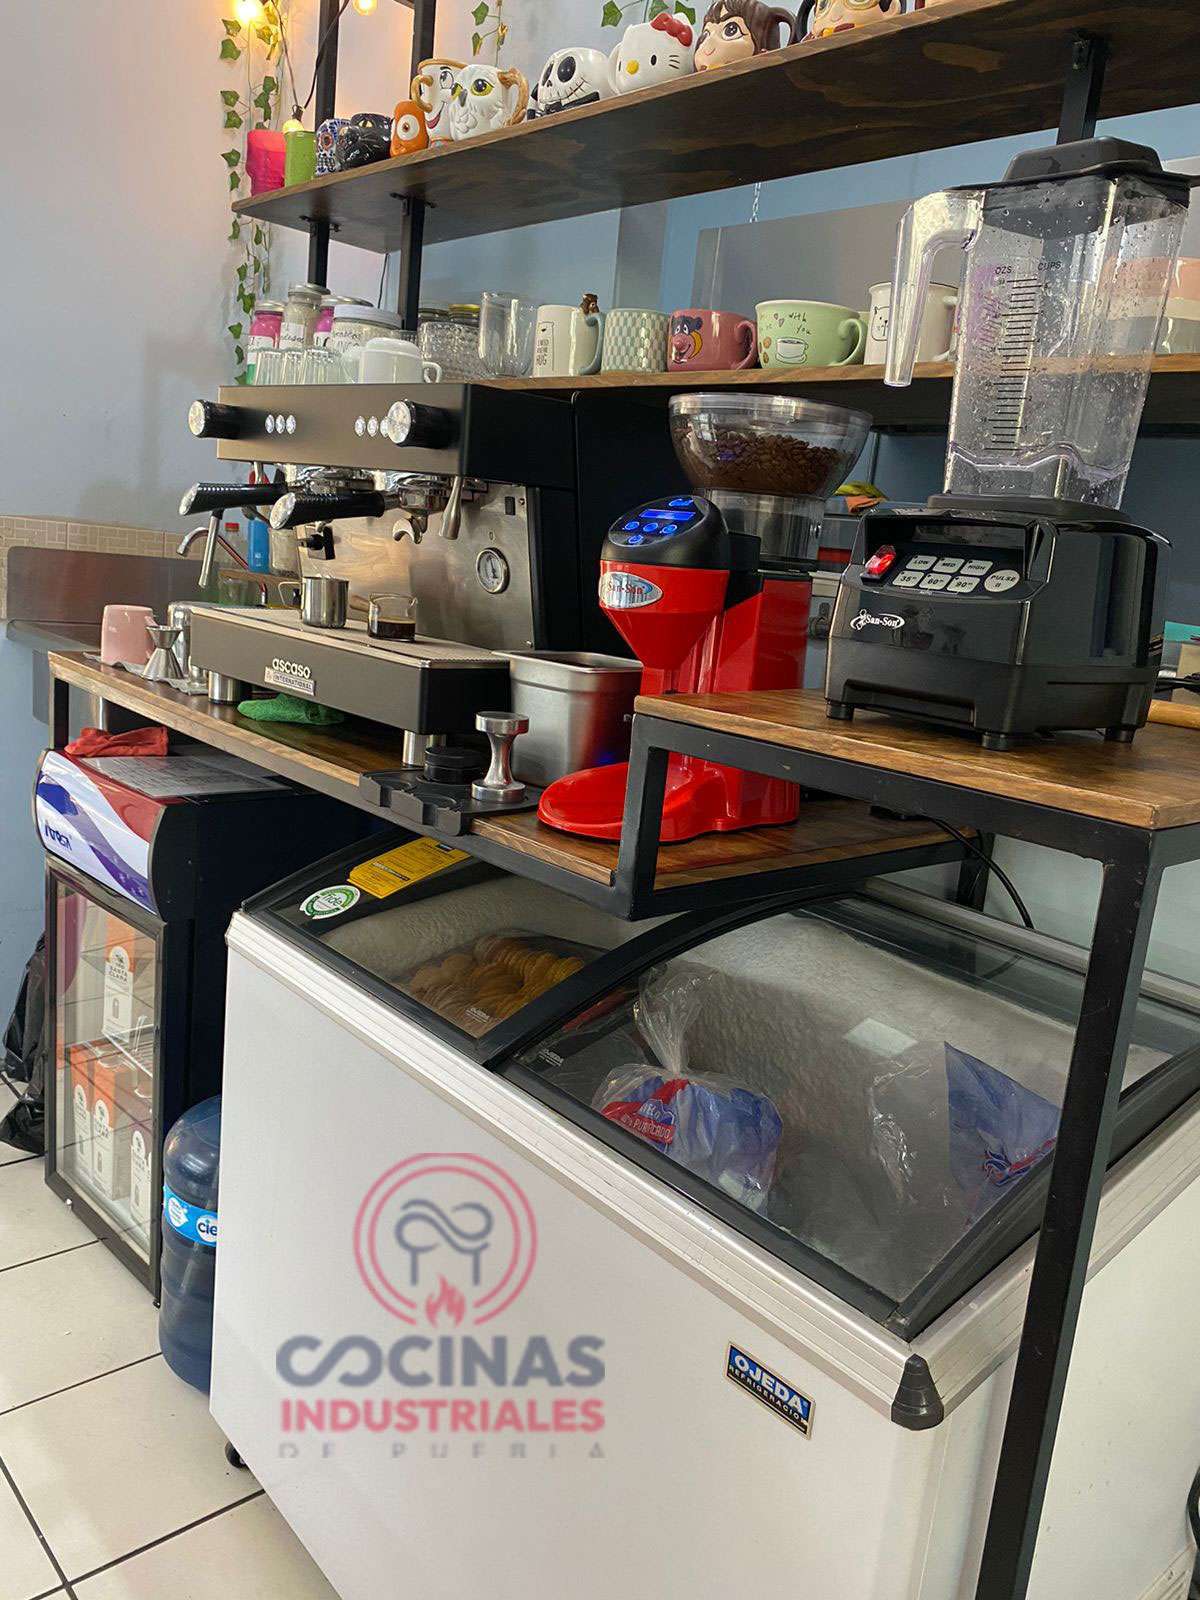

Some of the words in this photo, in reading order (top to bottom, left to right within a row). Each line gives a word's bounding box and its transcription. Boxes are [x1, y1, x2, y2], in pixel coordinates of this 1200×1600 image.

[995, 266, 1012, 275] OZS
[1037, 261, 1062, 271] CUPS
[990, 574, 1016, 582] PULSE
[866, 614, 897, 627] San-Son
[272, 658, 311, 679] ascaso
[273, 671, 313, 690] INTERNATIONAL
[734, 1355, 804, 1415] OJEDA
